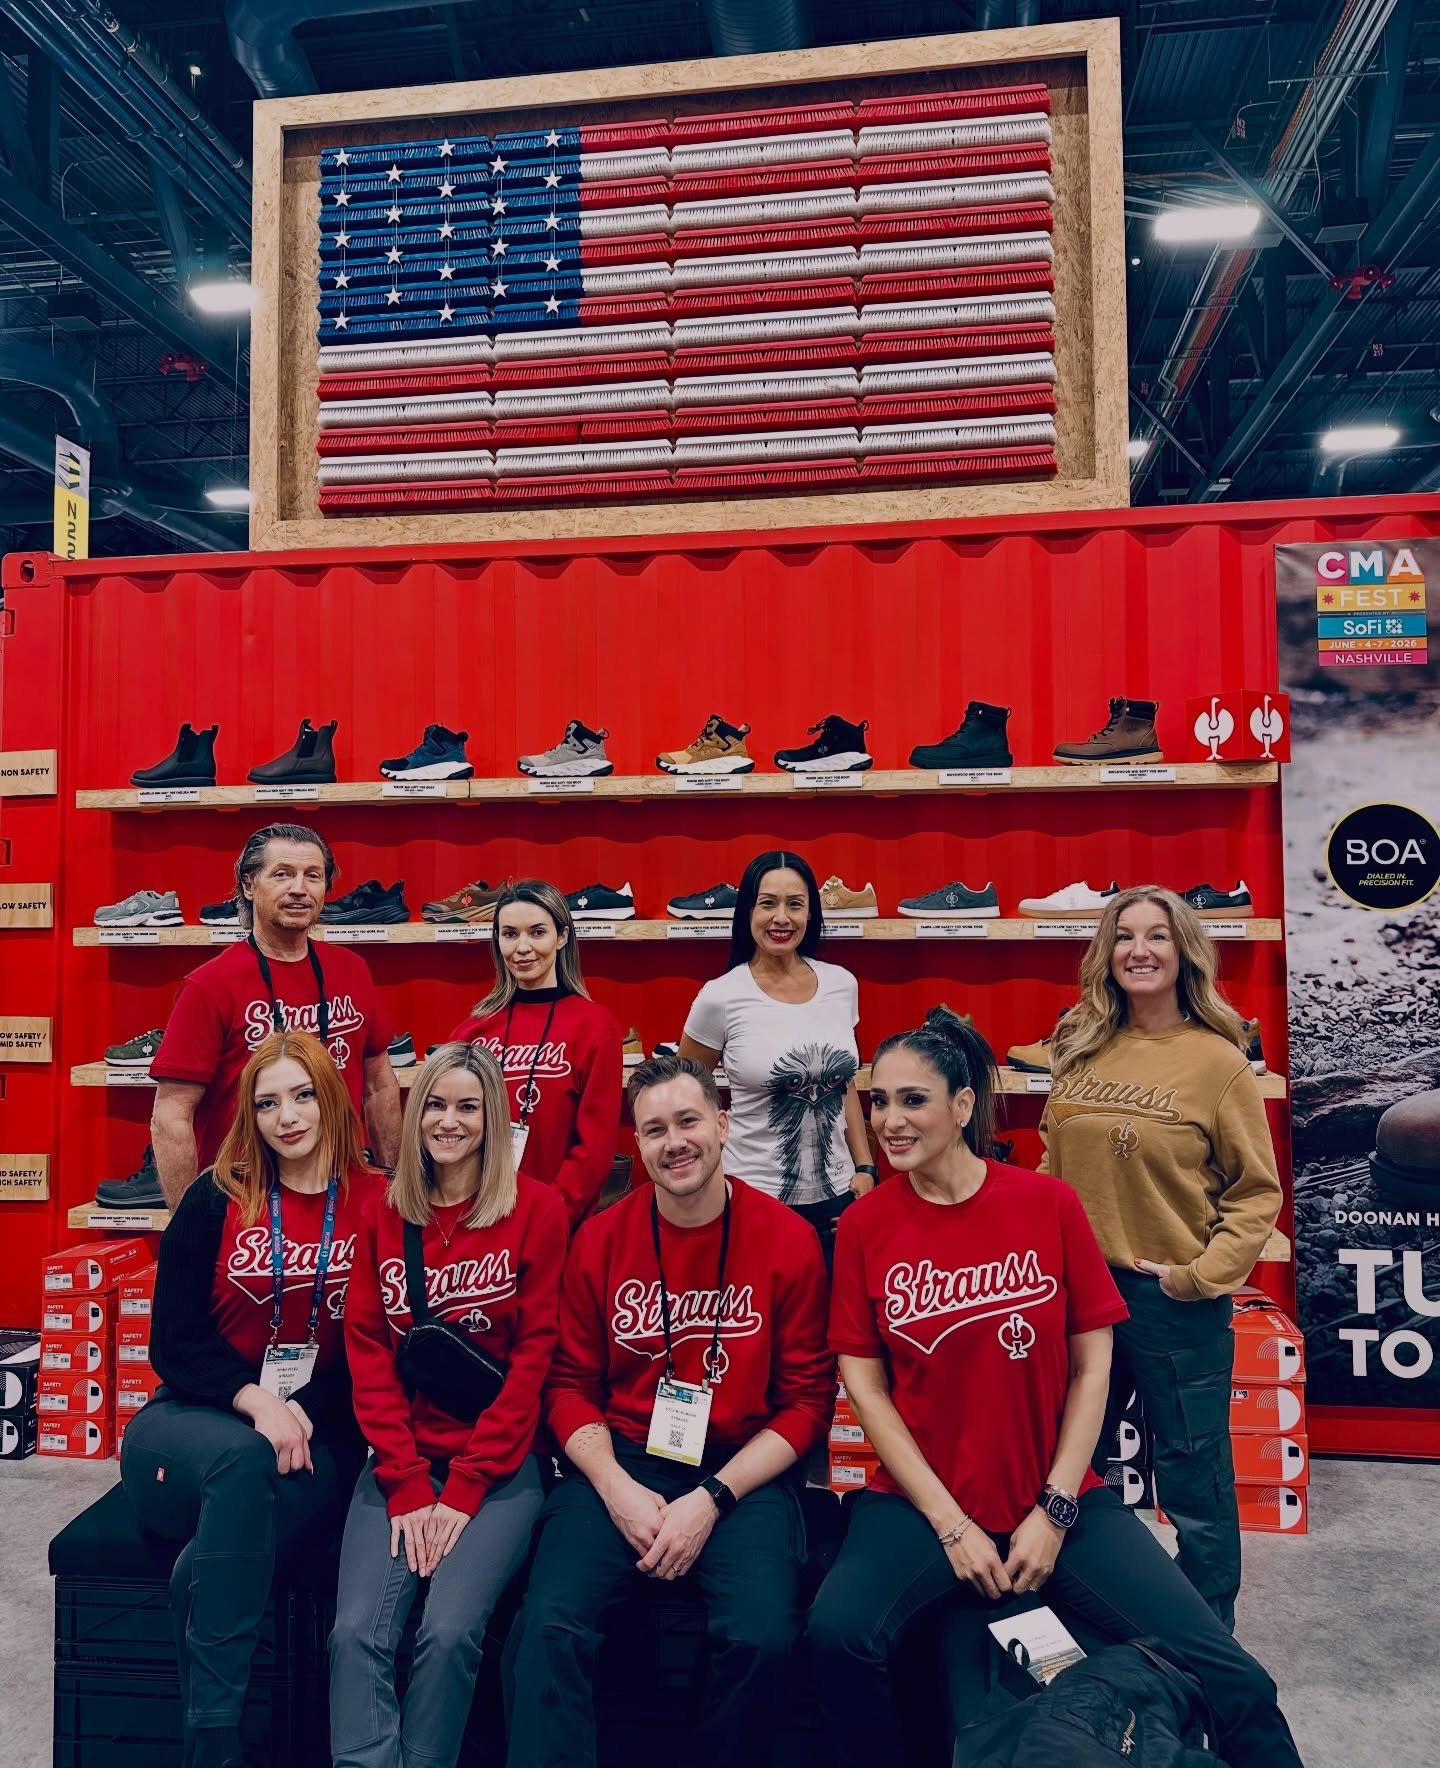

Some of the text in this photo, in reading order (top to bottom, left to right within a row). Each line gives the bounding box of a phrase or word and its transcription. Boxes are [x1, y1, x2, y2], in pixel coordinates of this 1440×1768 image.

[1317, 548, 1423, 579] CMA
[1340, 588, 1404, 606] FEST
[1343, 620, 1382, 635] SoFi
[1329, 640, 1356, 649] JUNE
[1335, 653, 1412, 664] NASHVILLE
[1346, 839, 1426, 864] BOA
[244, 995, 360, 1043] Srass
[1334, 1210, 1419, 1226] DOONAN
[380, 1248, 516, 1315] Srauss
[885, 1250, 1045, 1324] Strauss
[612, 1279, 756, 1335] Strauss
[1338, 1328, 1434, 1379] TO
